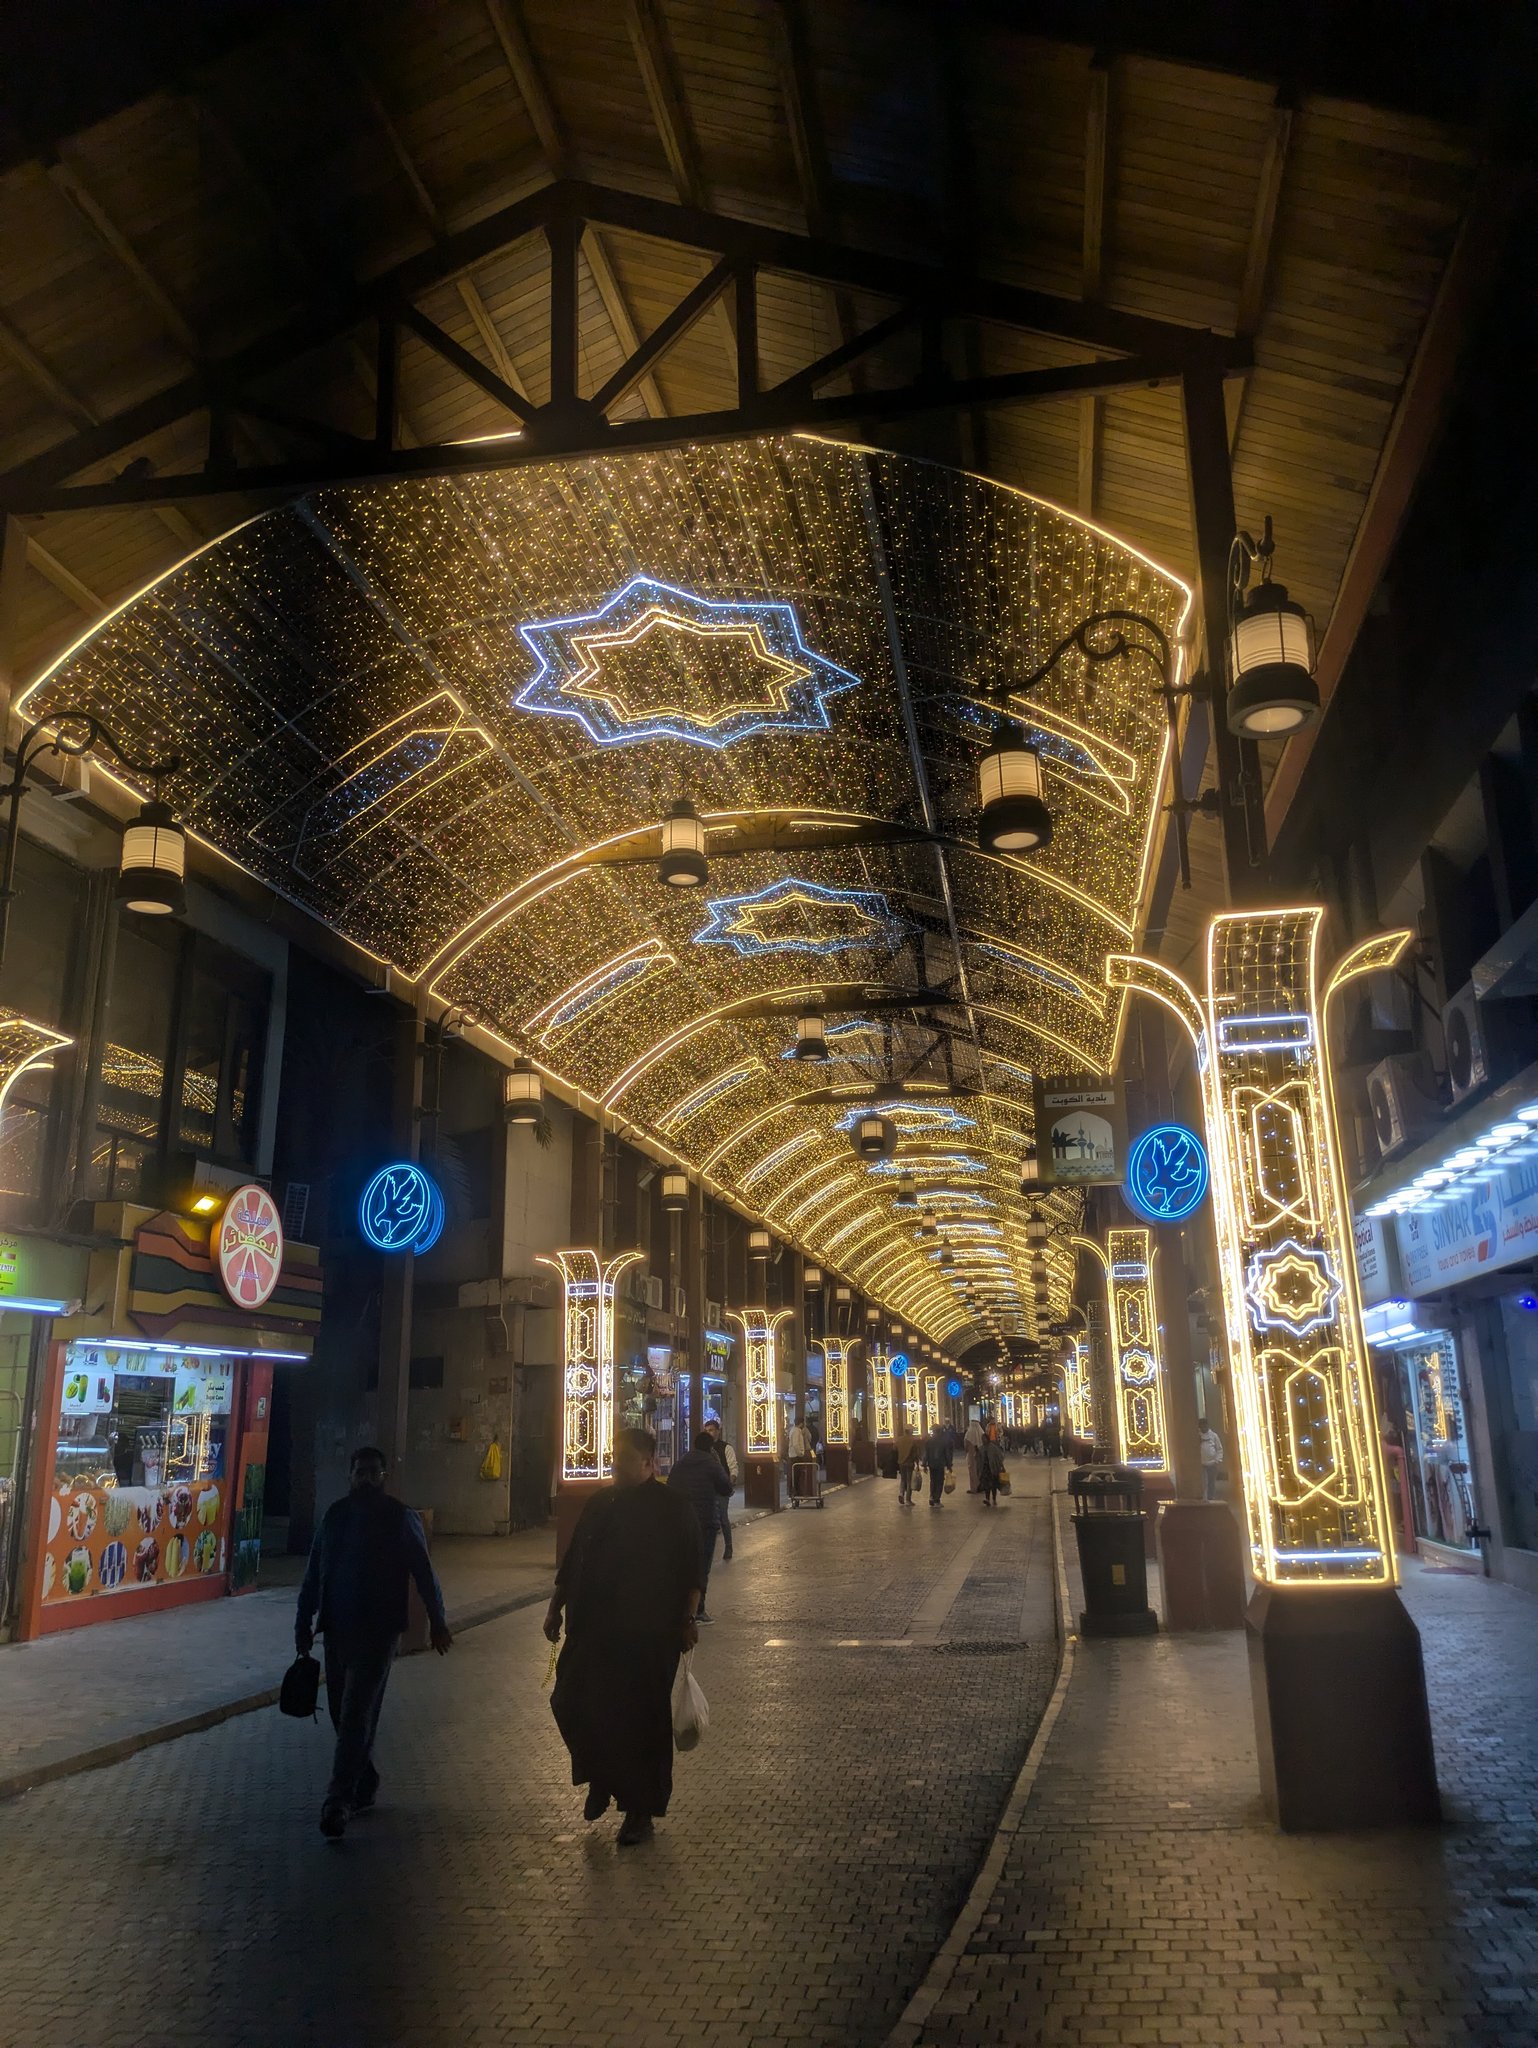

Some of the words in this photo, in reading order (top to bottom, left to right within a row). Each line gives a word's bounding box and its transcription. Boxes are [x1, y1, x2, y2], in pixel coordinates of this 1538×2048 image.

[1051, 1094, 1083, 1106] الكويت
[1086, 1093, 1107, 1105] بلدية
[237, 1207, 271, 1227] مملكة
[1432, 1201, 1471, 1250] SINYAR
[223, 1229, 280, 1260] العصائر
